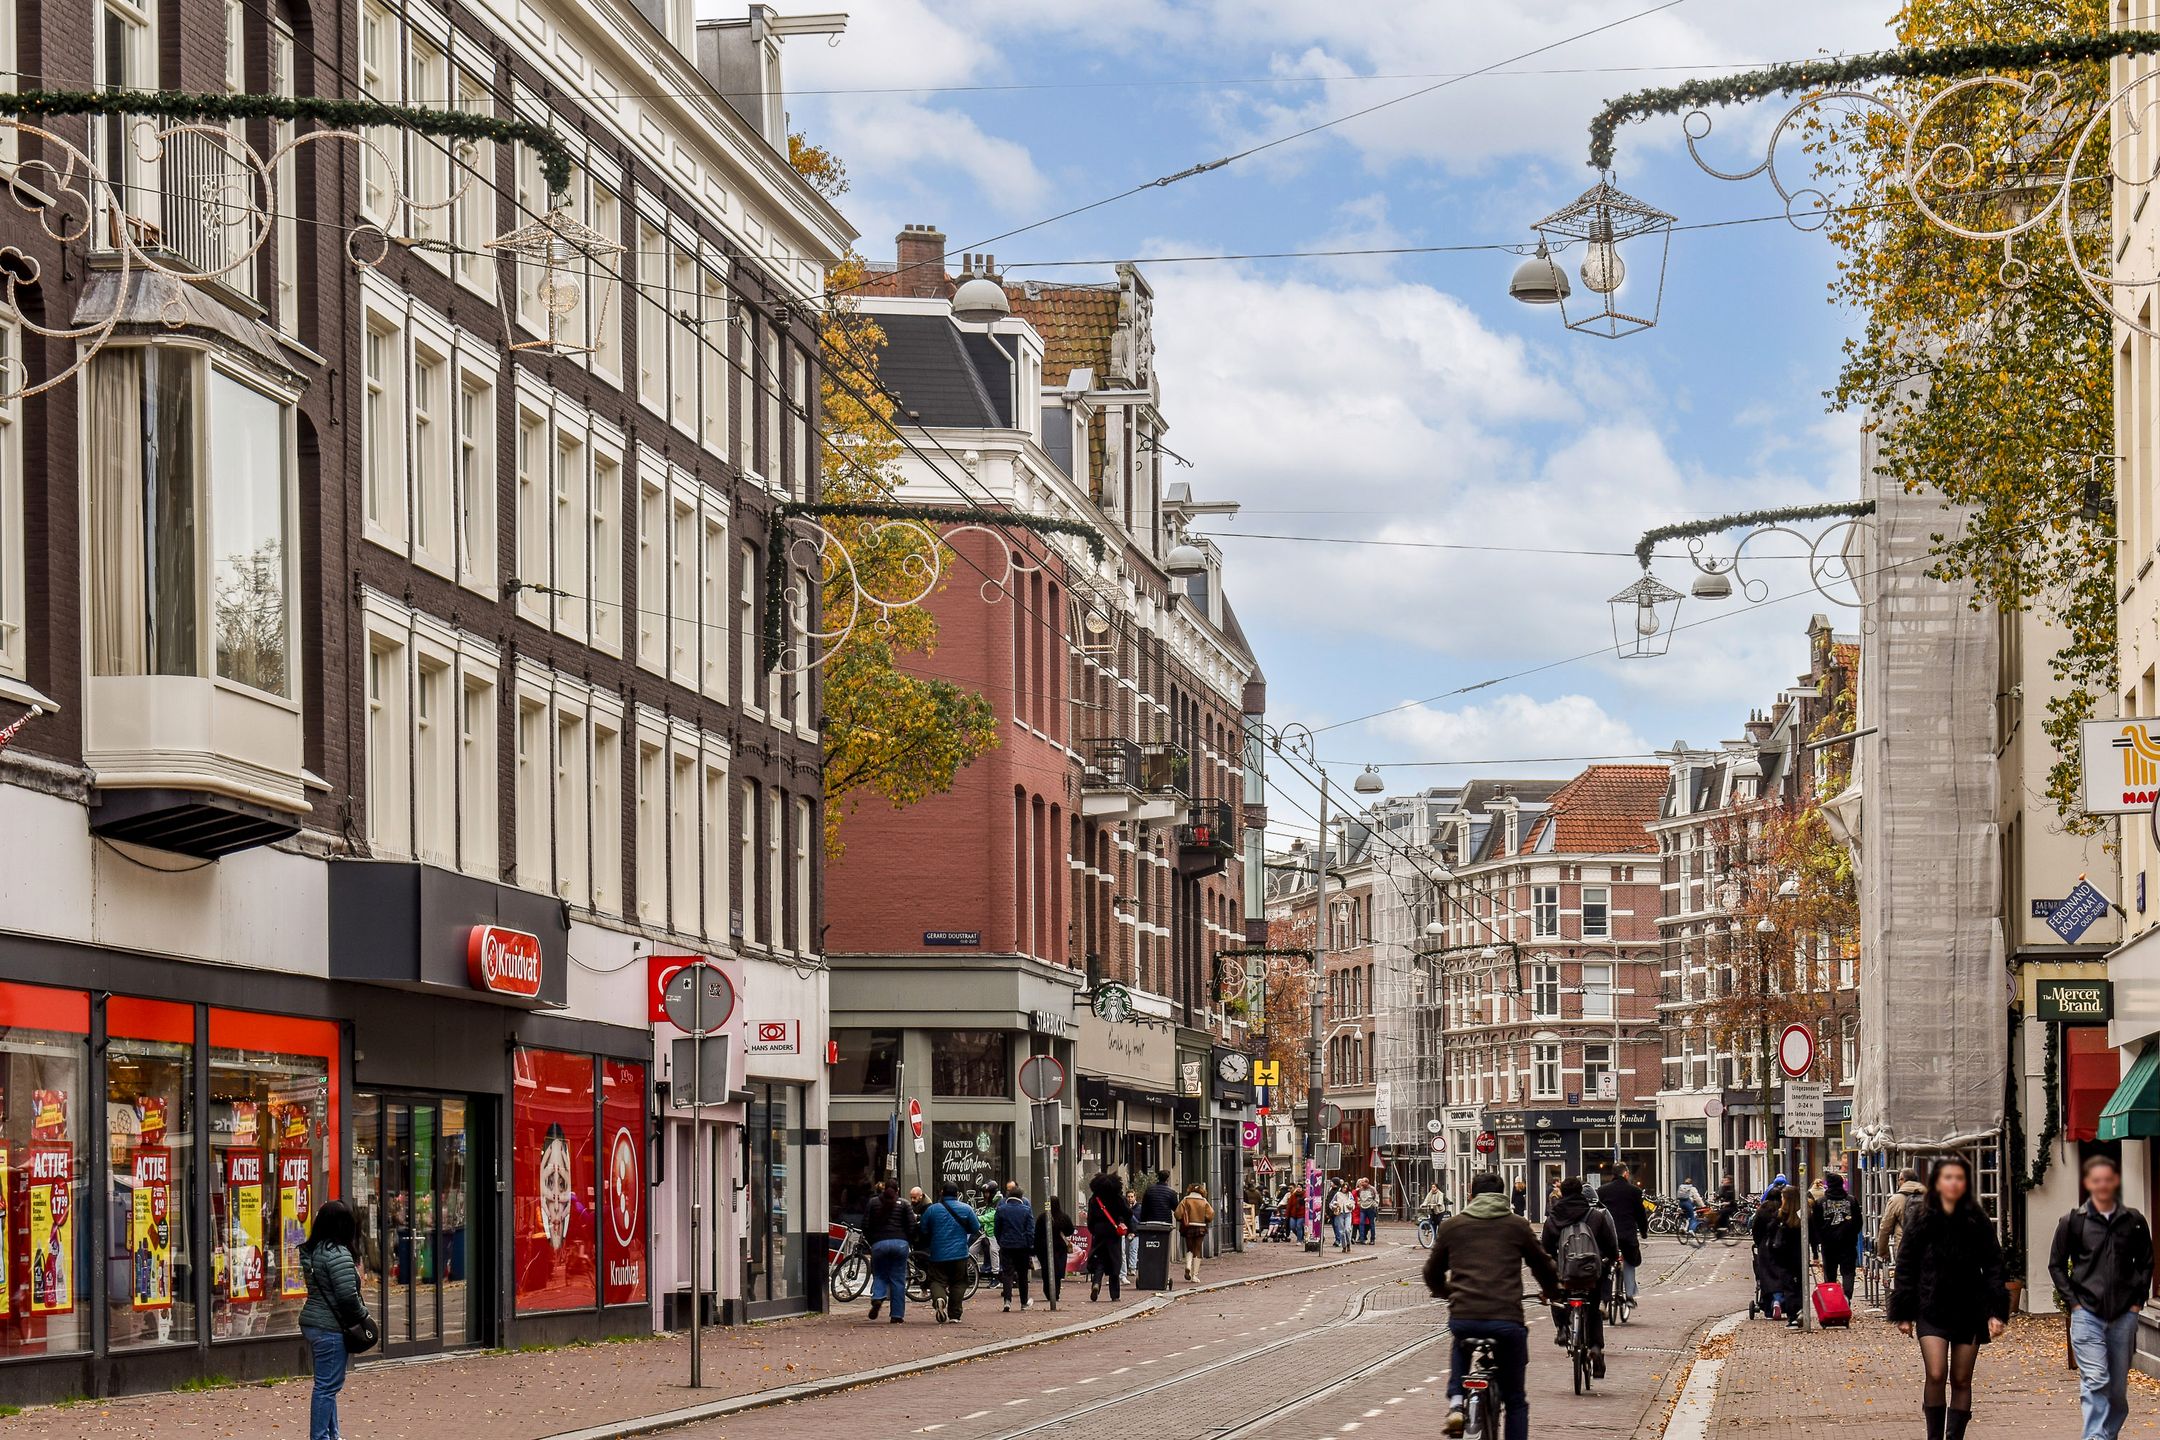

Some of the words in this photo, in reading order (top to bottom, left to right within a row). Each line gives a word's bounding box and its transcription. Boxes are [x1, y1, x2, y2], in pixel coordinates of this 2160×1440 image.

[2048, 884, 2090, 928] FERDINAND
[2059, 894, 2098, 935] BOLSTRAAT
[2080, 902, 2104, 927] OUD-ZUID
[498, 942, 538, 982] Kruidvat
[2052, 988, 2100, 1000] Mercer
[1036, 1010, 1066, 1038] STARBUCKS
[34, 1152, 68, 1178] ACTIE!
[136, 1156, 166, 1182] ACTIE!
[232, 1158, 260, 1182] ACTIE!
[283, 1159, 309, 1182] ACTIE!
[942, 1150, 992, 1172] Amsterdam
[610, 1259, 639, 1286] Kruidvat
